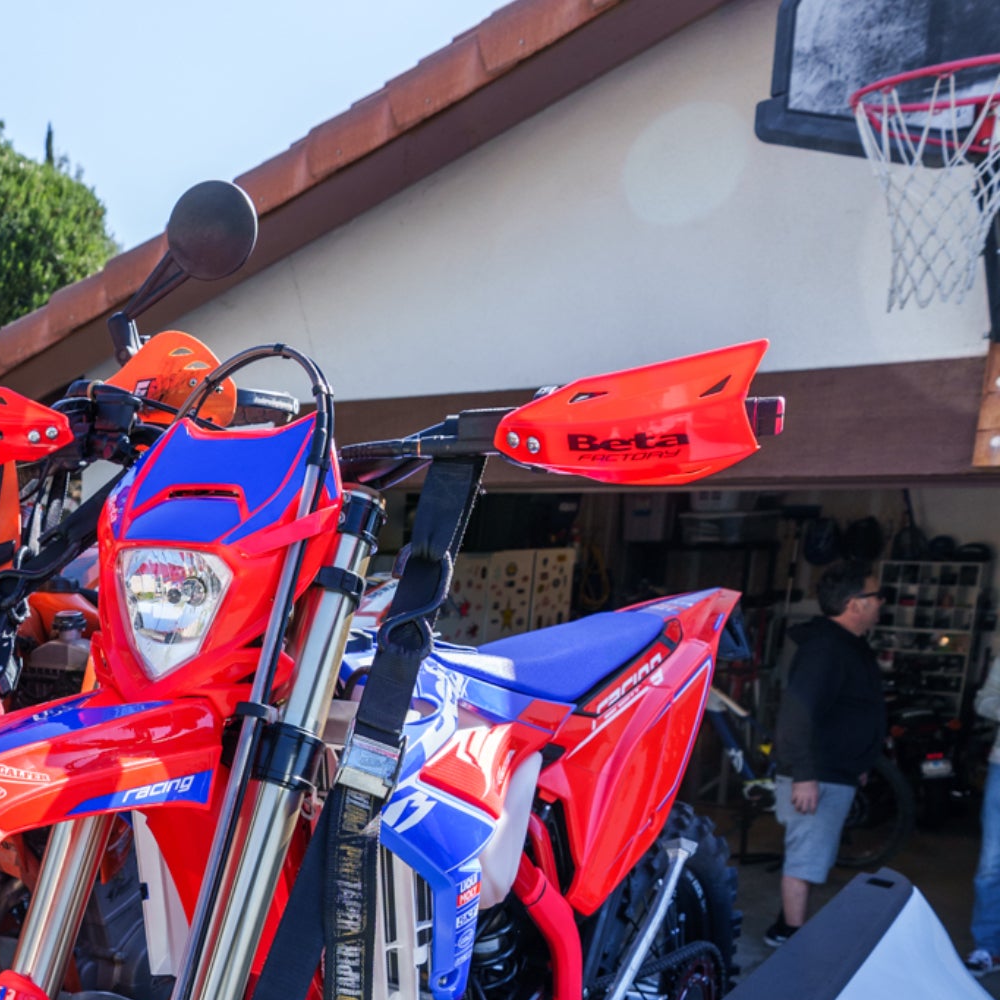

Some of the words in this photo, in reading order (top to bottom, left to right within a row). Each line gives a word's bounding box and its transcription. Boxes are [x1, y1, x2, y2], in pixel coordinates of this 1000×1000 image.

[567, 432, 690, 452] Beta
[577, 449, 682, 463] FACTORY
[121, 774, 195, 803] racing
